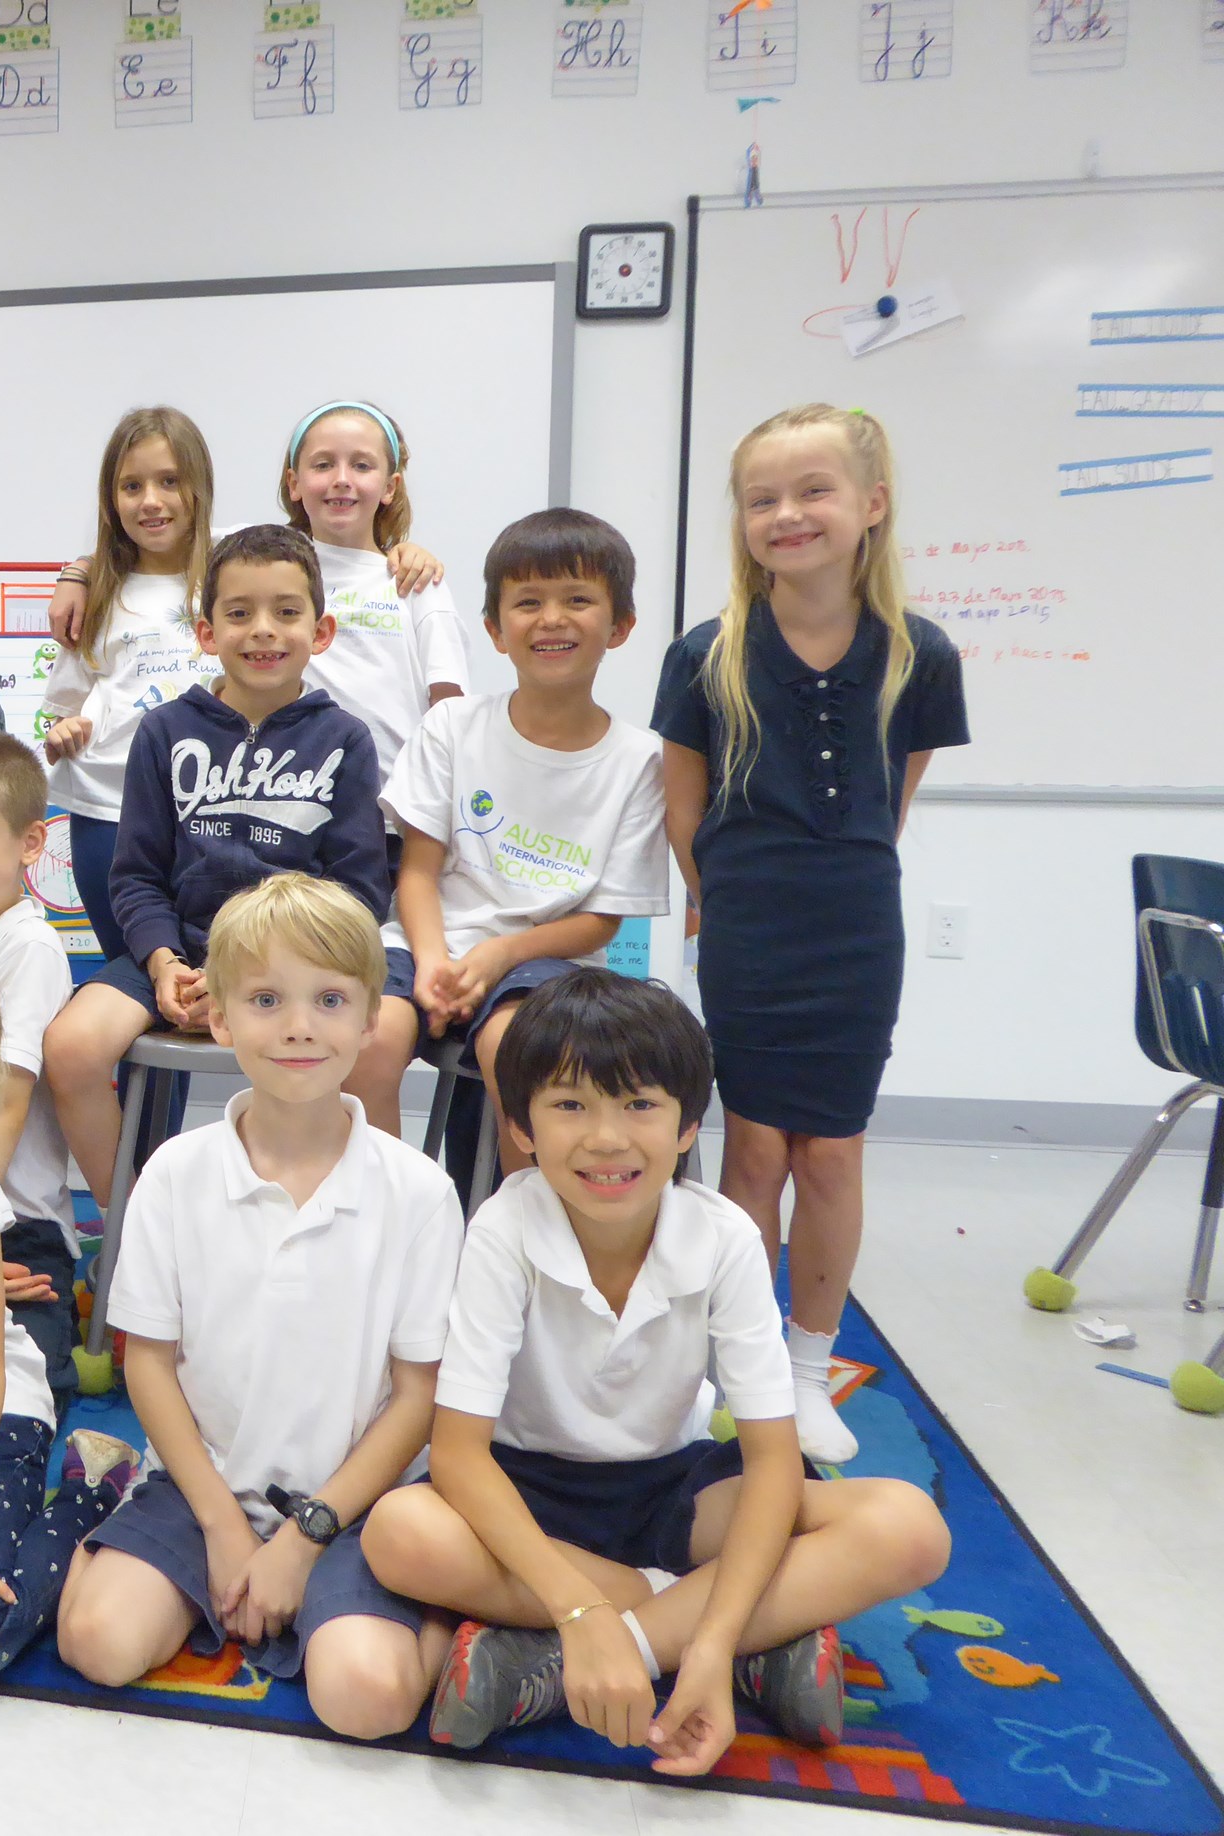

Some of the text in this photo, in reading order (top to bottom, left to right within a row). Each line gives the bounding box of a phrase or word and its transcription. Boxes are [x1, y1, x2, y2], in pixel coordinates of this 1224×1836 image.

[561, 19, 633, 68] Hh
[121, 54, 178, 99] Ee
[406, 33, 477, 109] Gg
[1008, 604, 1050, 624] 2015
[137, 659, 182, 677] Fund
[171, 738, 345, 823] OshKosh
[189, 819, 283, 846] SINCE 1895
[503, 823, 593, 867] AUSTIN
[493, 853, 581, 893] SCHOOL
[498, 840, 586, 878] INTERNATIONAL
[625, 942, 639, 950] me
[628, 957, 644, 965] me
